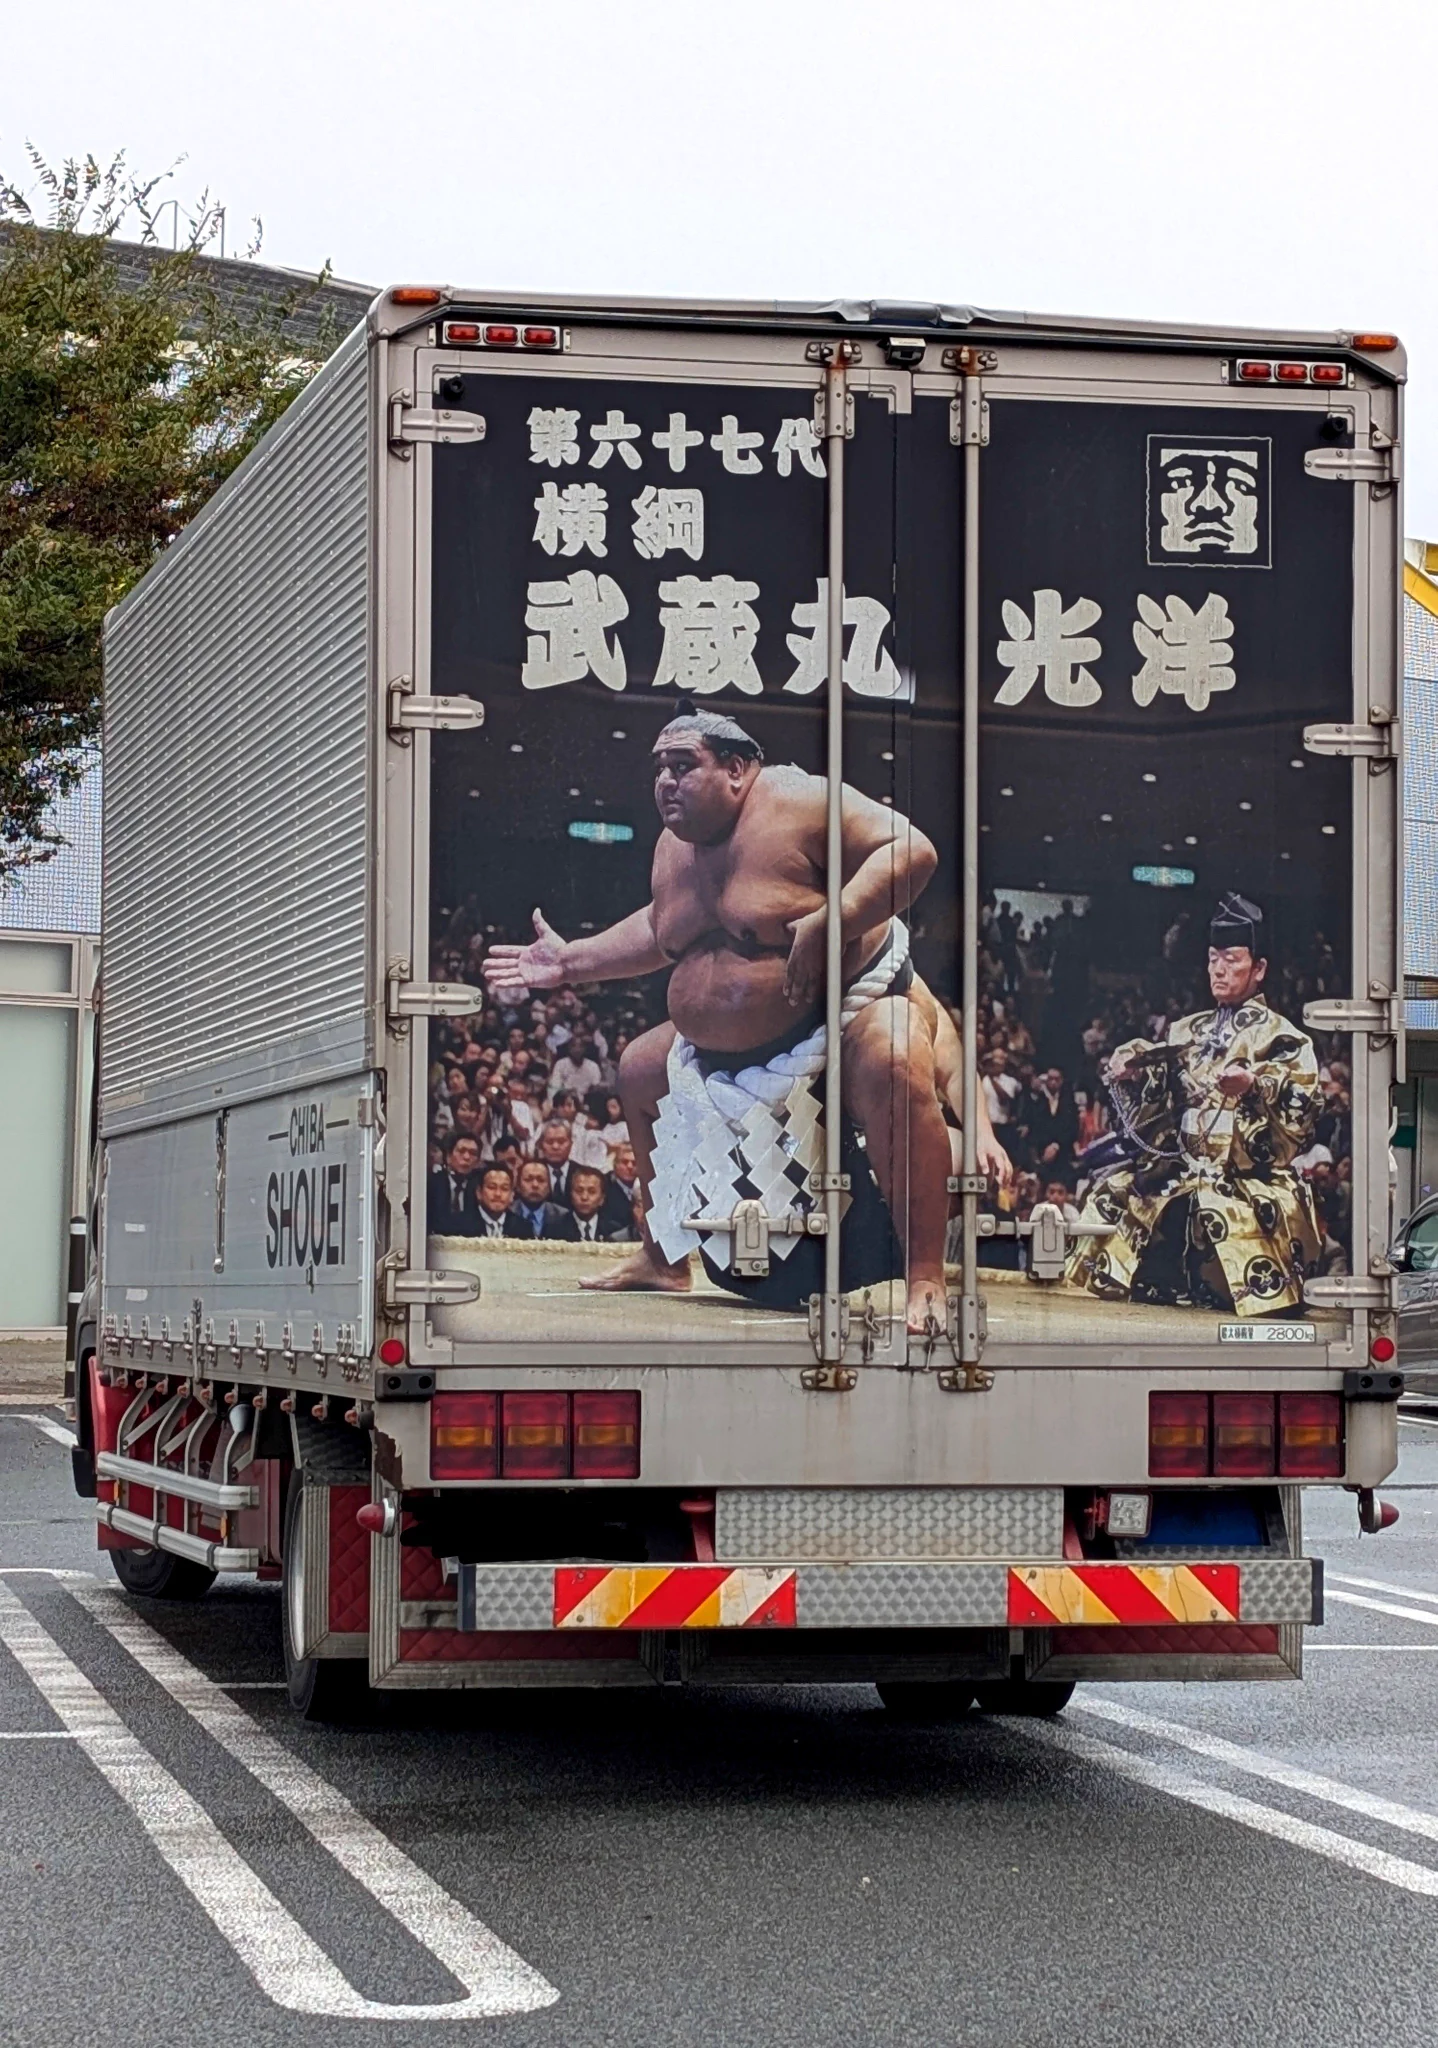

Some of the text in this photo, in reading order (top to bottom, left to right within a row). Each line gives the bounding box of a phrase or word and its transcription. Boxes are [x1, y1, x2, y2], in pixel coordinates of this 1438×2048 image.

[527, 407, 827, 478] 第六十七代
[532, 482, 704, 561] 横綱
[521, 569, 1237, 711] 武蔵丸 光洋
[290, 1104, 325, 1156] CHIBA
[266, 1163, 346, 1269] SHOUEI
